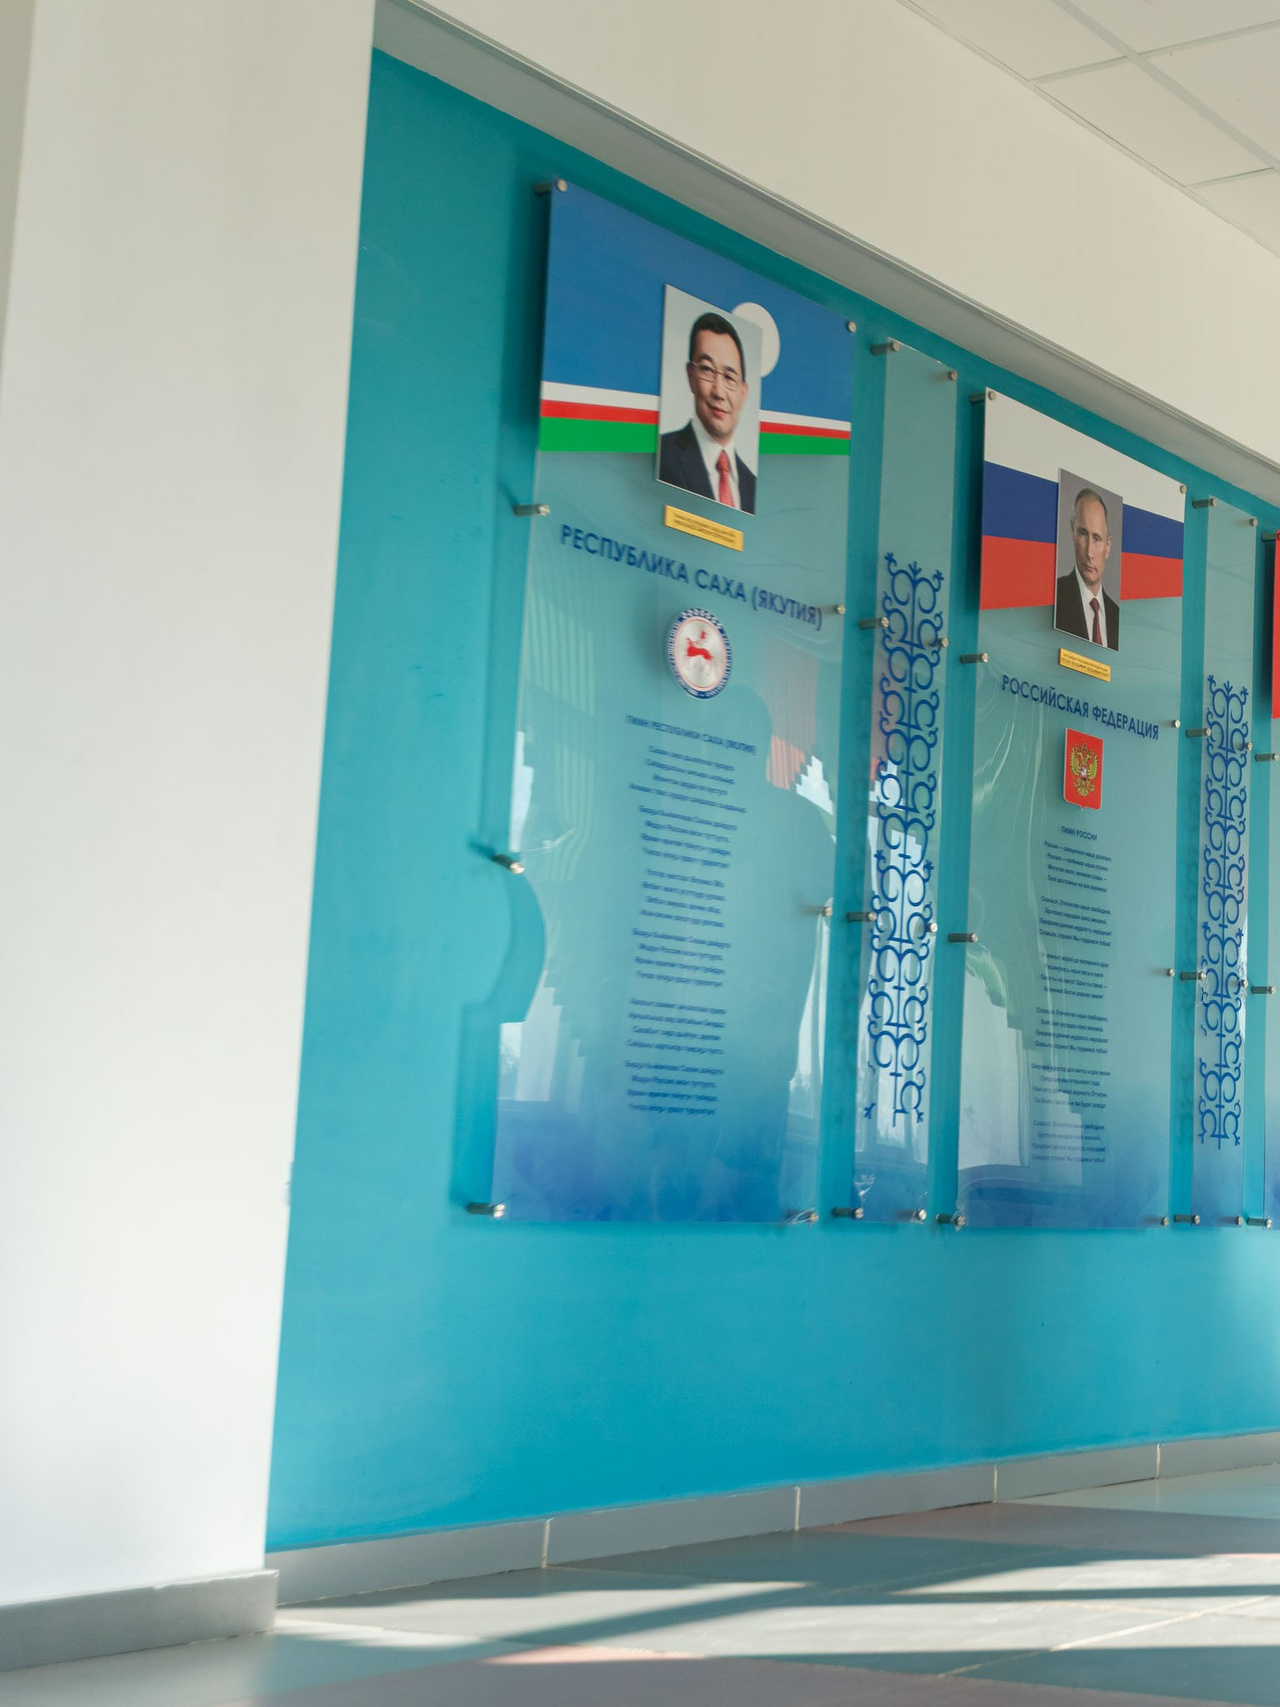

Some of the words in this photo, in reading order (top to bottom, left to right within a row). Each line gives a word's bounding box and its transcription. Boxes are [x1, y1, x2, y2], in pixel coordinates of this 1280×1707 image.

[560, 524, 690, 584] РЕСПУБЛИКА
[694, 569, 747, 602] САХА
[752, 586, 823, 631] (ЯКУТИЯ)
[1002, 674, 1089, 718] РОССИЙСКАЯ
[1092, 705, 1160, 740] ФЕДЕРАЦИЯ
